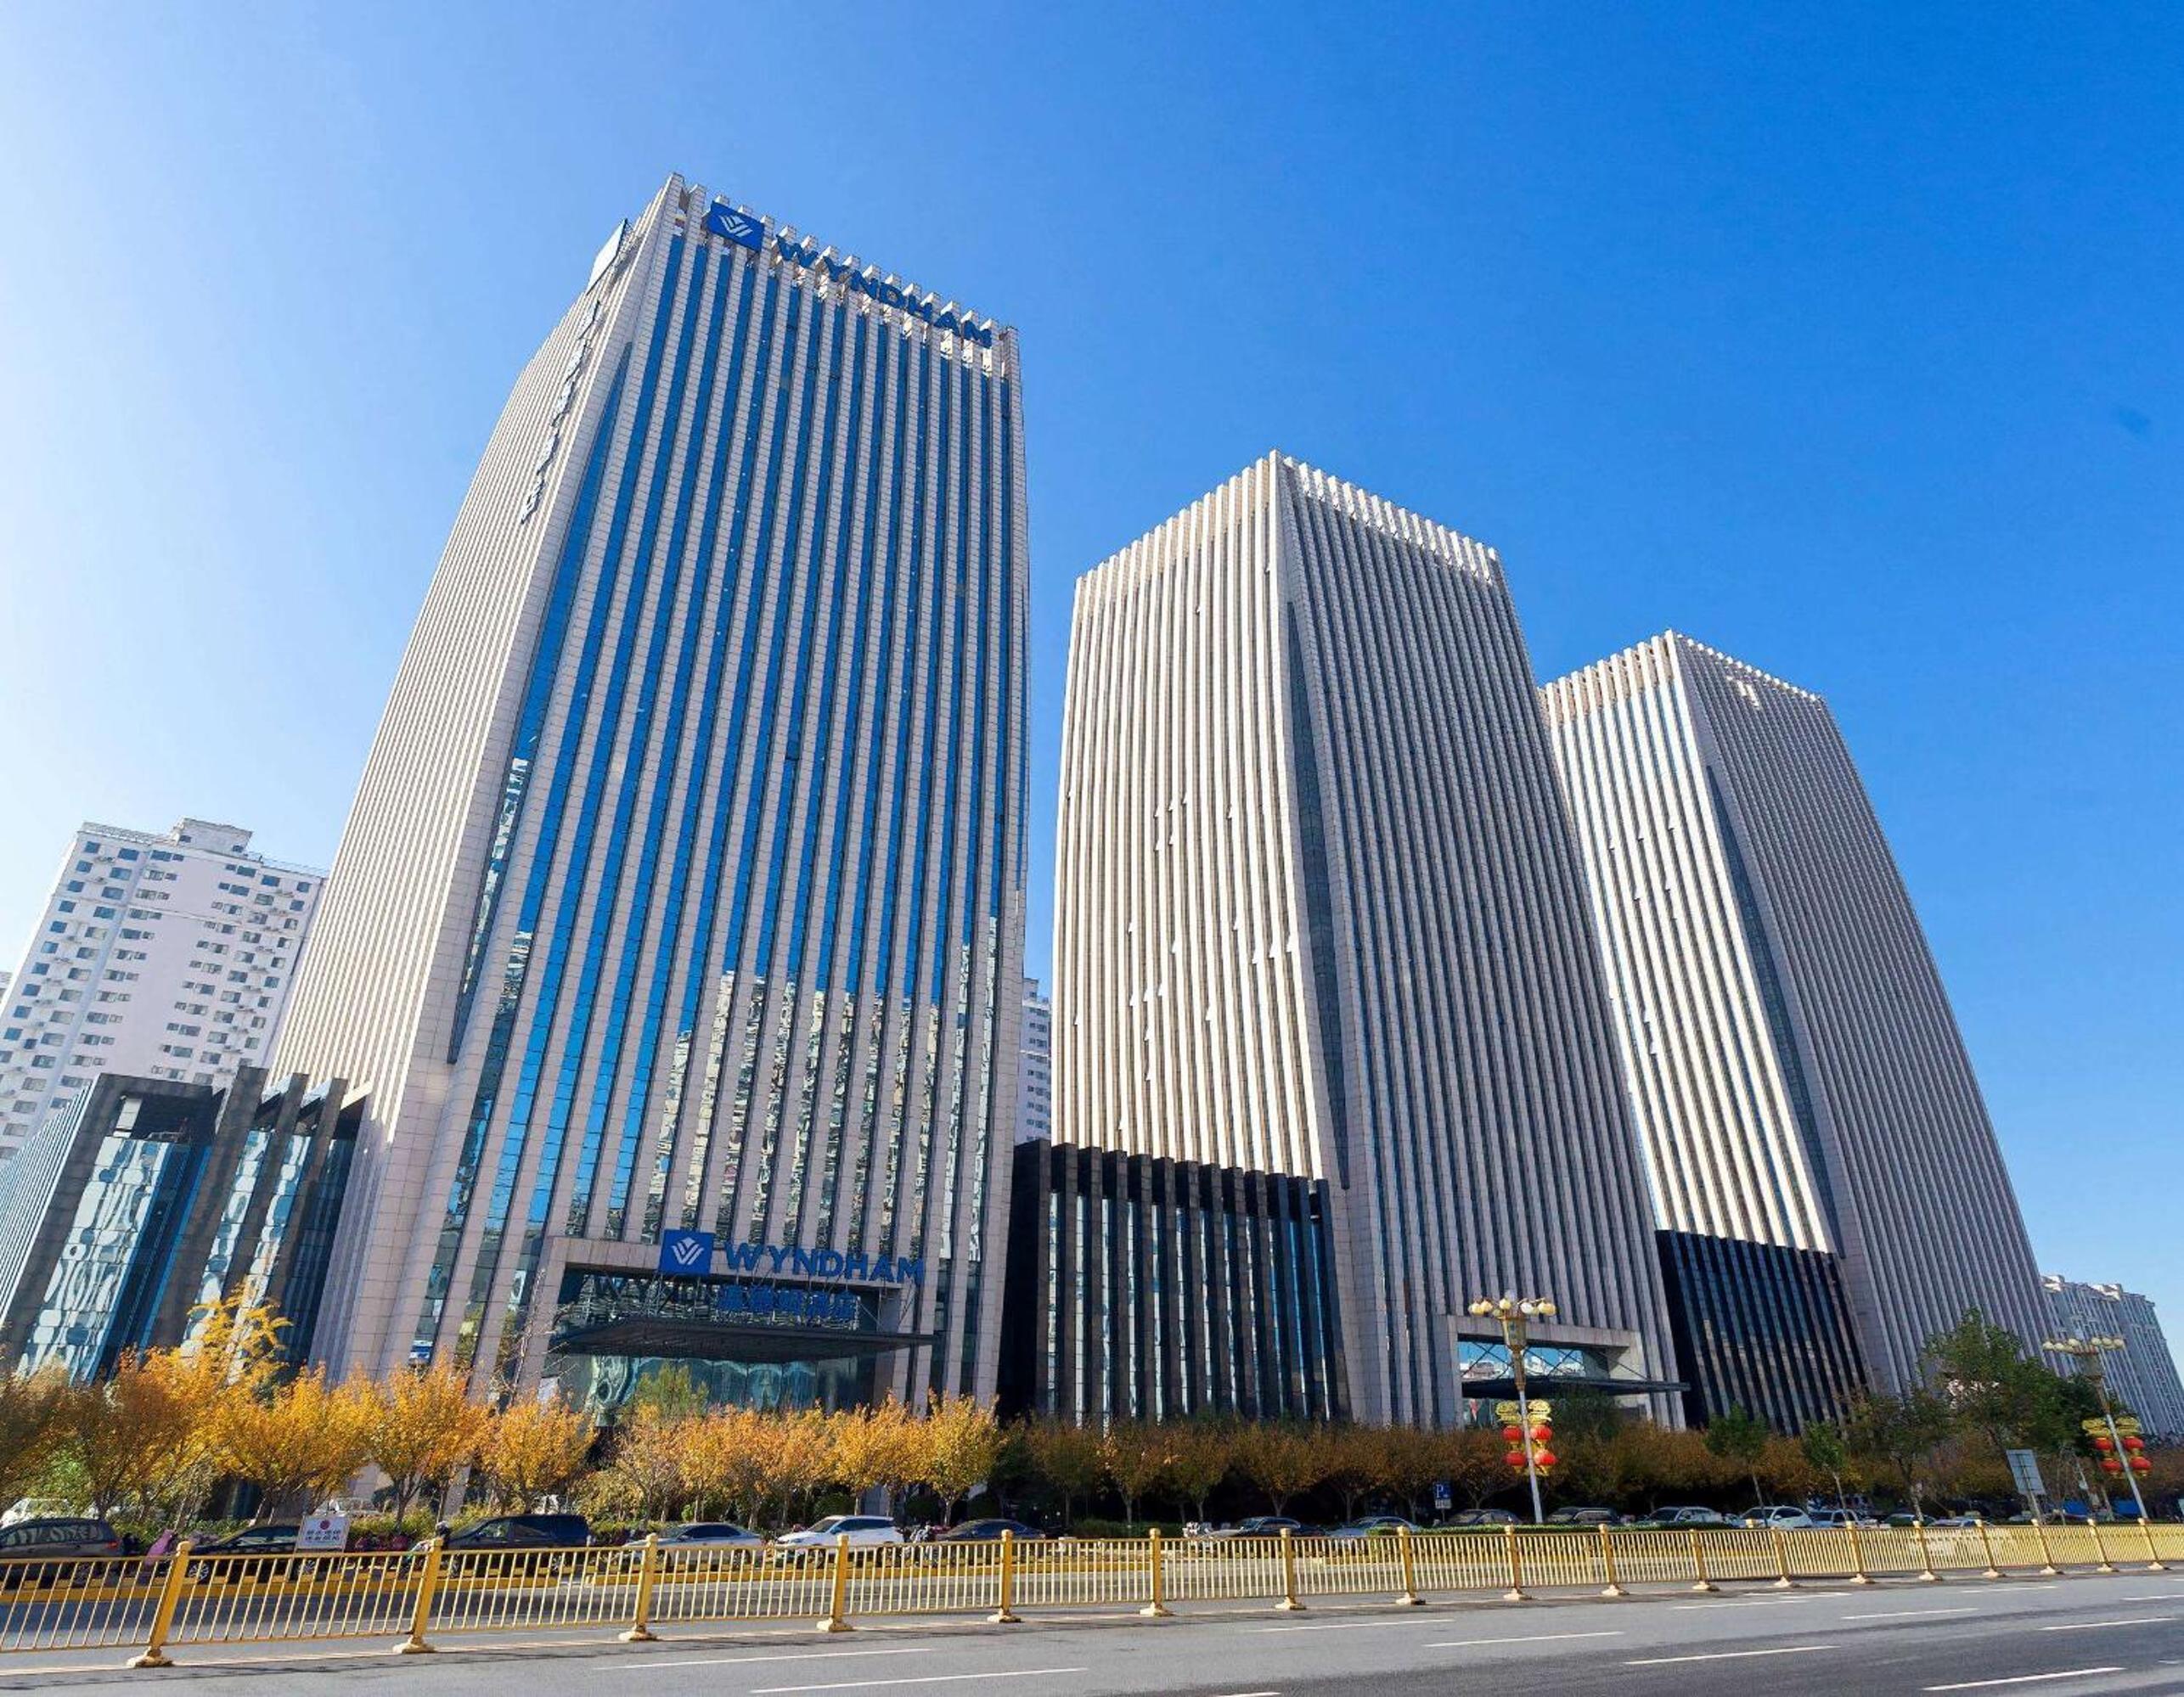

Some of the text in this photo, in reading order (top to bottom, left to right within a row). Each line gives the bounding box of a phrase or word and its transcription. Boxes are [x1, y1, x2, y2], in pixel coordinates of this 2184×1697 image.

[776, 234, 992, 348] WYNDHAM
[724, 1242, 924, 1285] WYNDHAM
[1436, 1484, 1444, 1498] P
